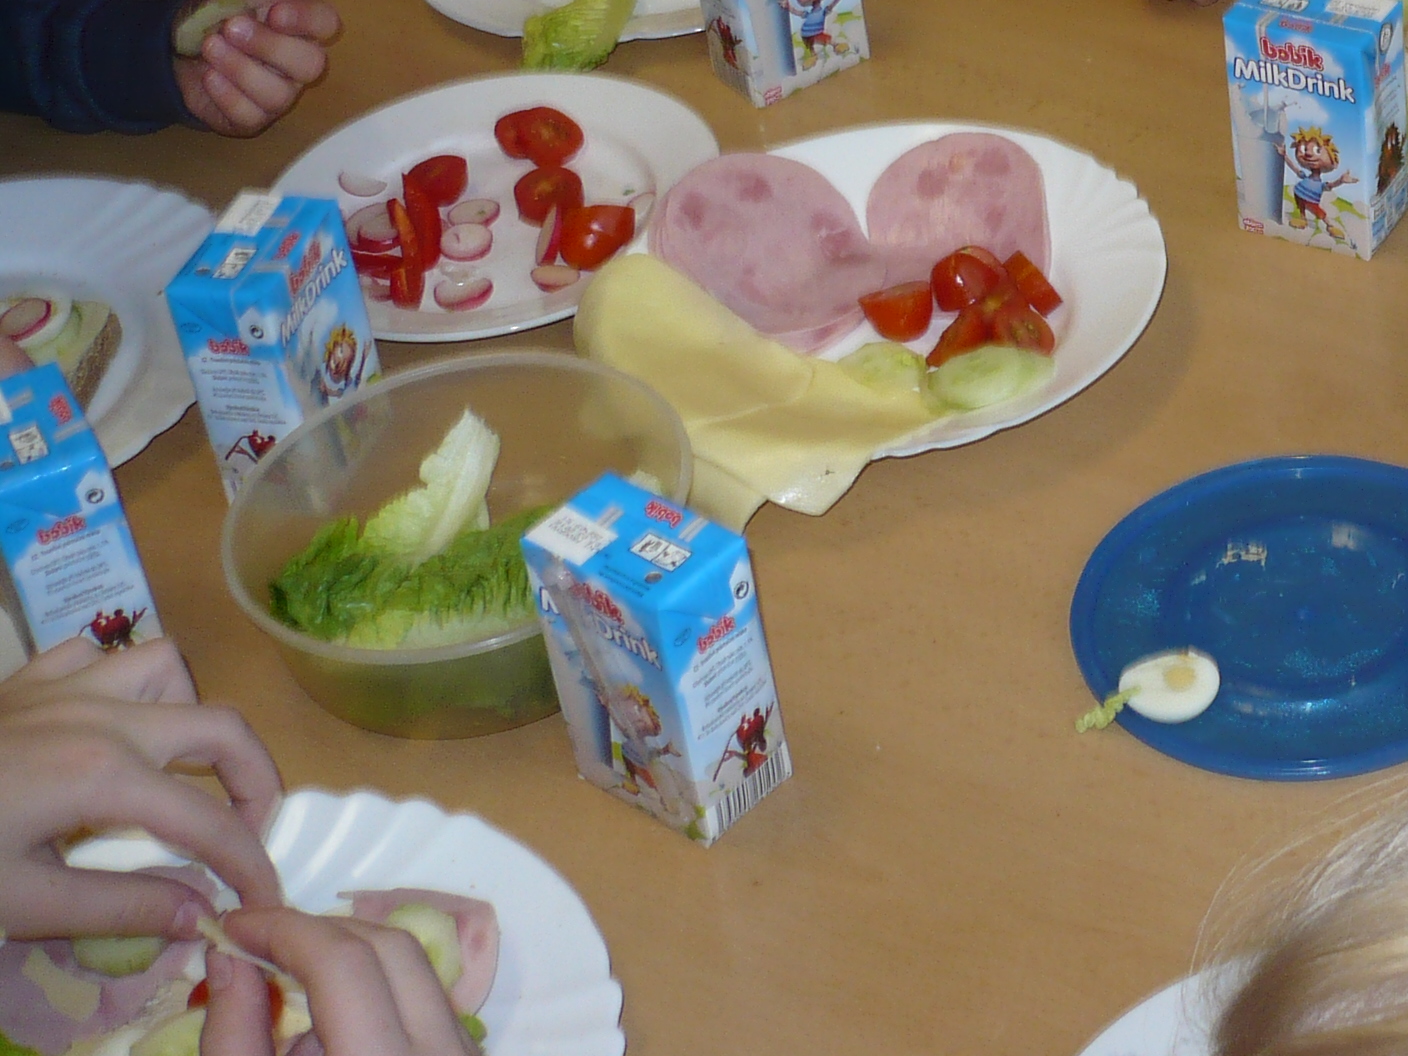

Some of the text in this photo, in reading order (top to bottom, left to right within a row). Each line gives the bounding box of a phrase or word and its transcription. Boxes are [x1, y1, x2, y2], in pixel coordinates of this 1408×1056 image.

[1259, 37, 1324, 71] bobik
[1233, 58, 1356, 104] MilkDrink
[280, 248, 347, 347] MilkDrink
[36, 515, 86, 545] bobik
[539, 586, 663, 672] MDrink
[697, 615, 736, 654] bobik
